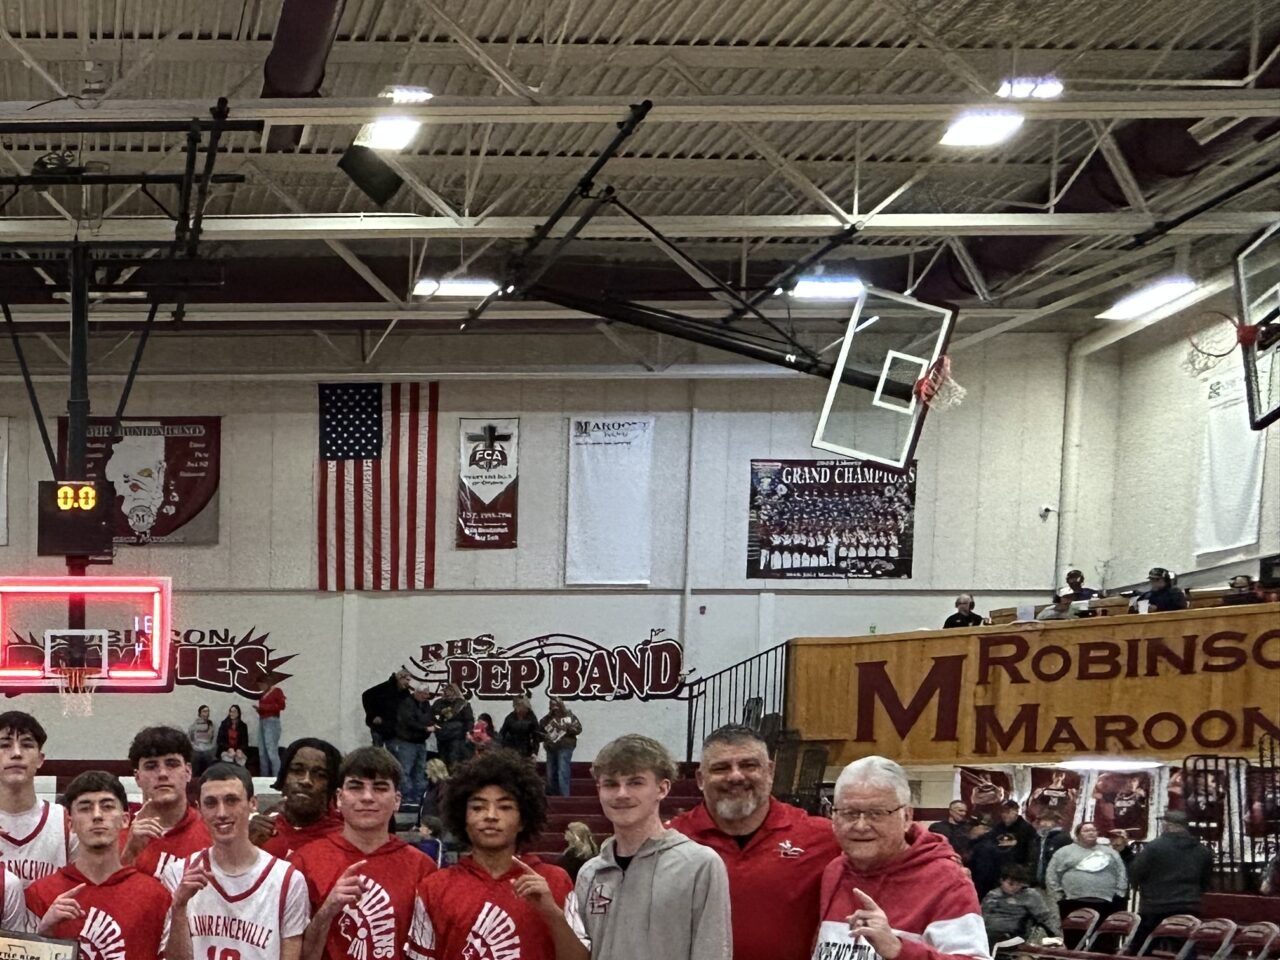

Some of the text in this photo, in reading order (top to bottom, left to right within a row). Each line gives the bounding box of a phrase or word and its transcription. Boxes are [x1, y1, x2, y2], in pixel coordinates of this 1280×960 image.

[475, 452, 502, 461] FCA
[782, 467, 830, 484] GRAND
[57, 486, 96, 510] 0.0
[420, 634, 495, 662] RHS
[448, 640, 683, 698] PEP BAND
[855, 654, 966, 742] M
